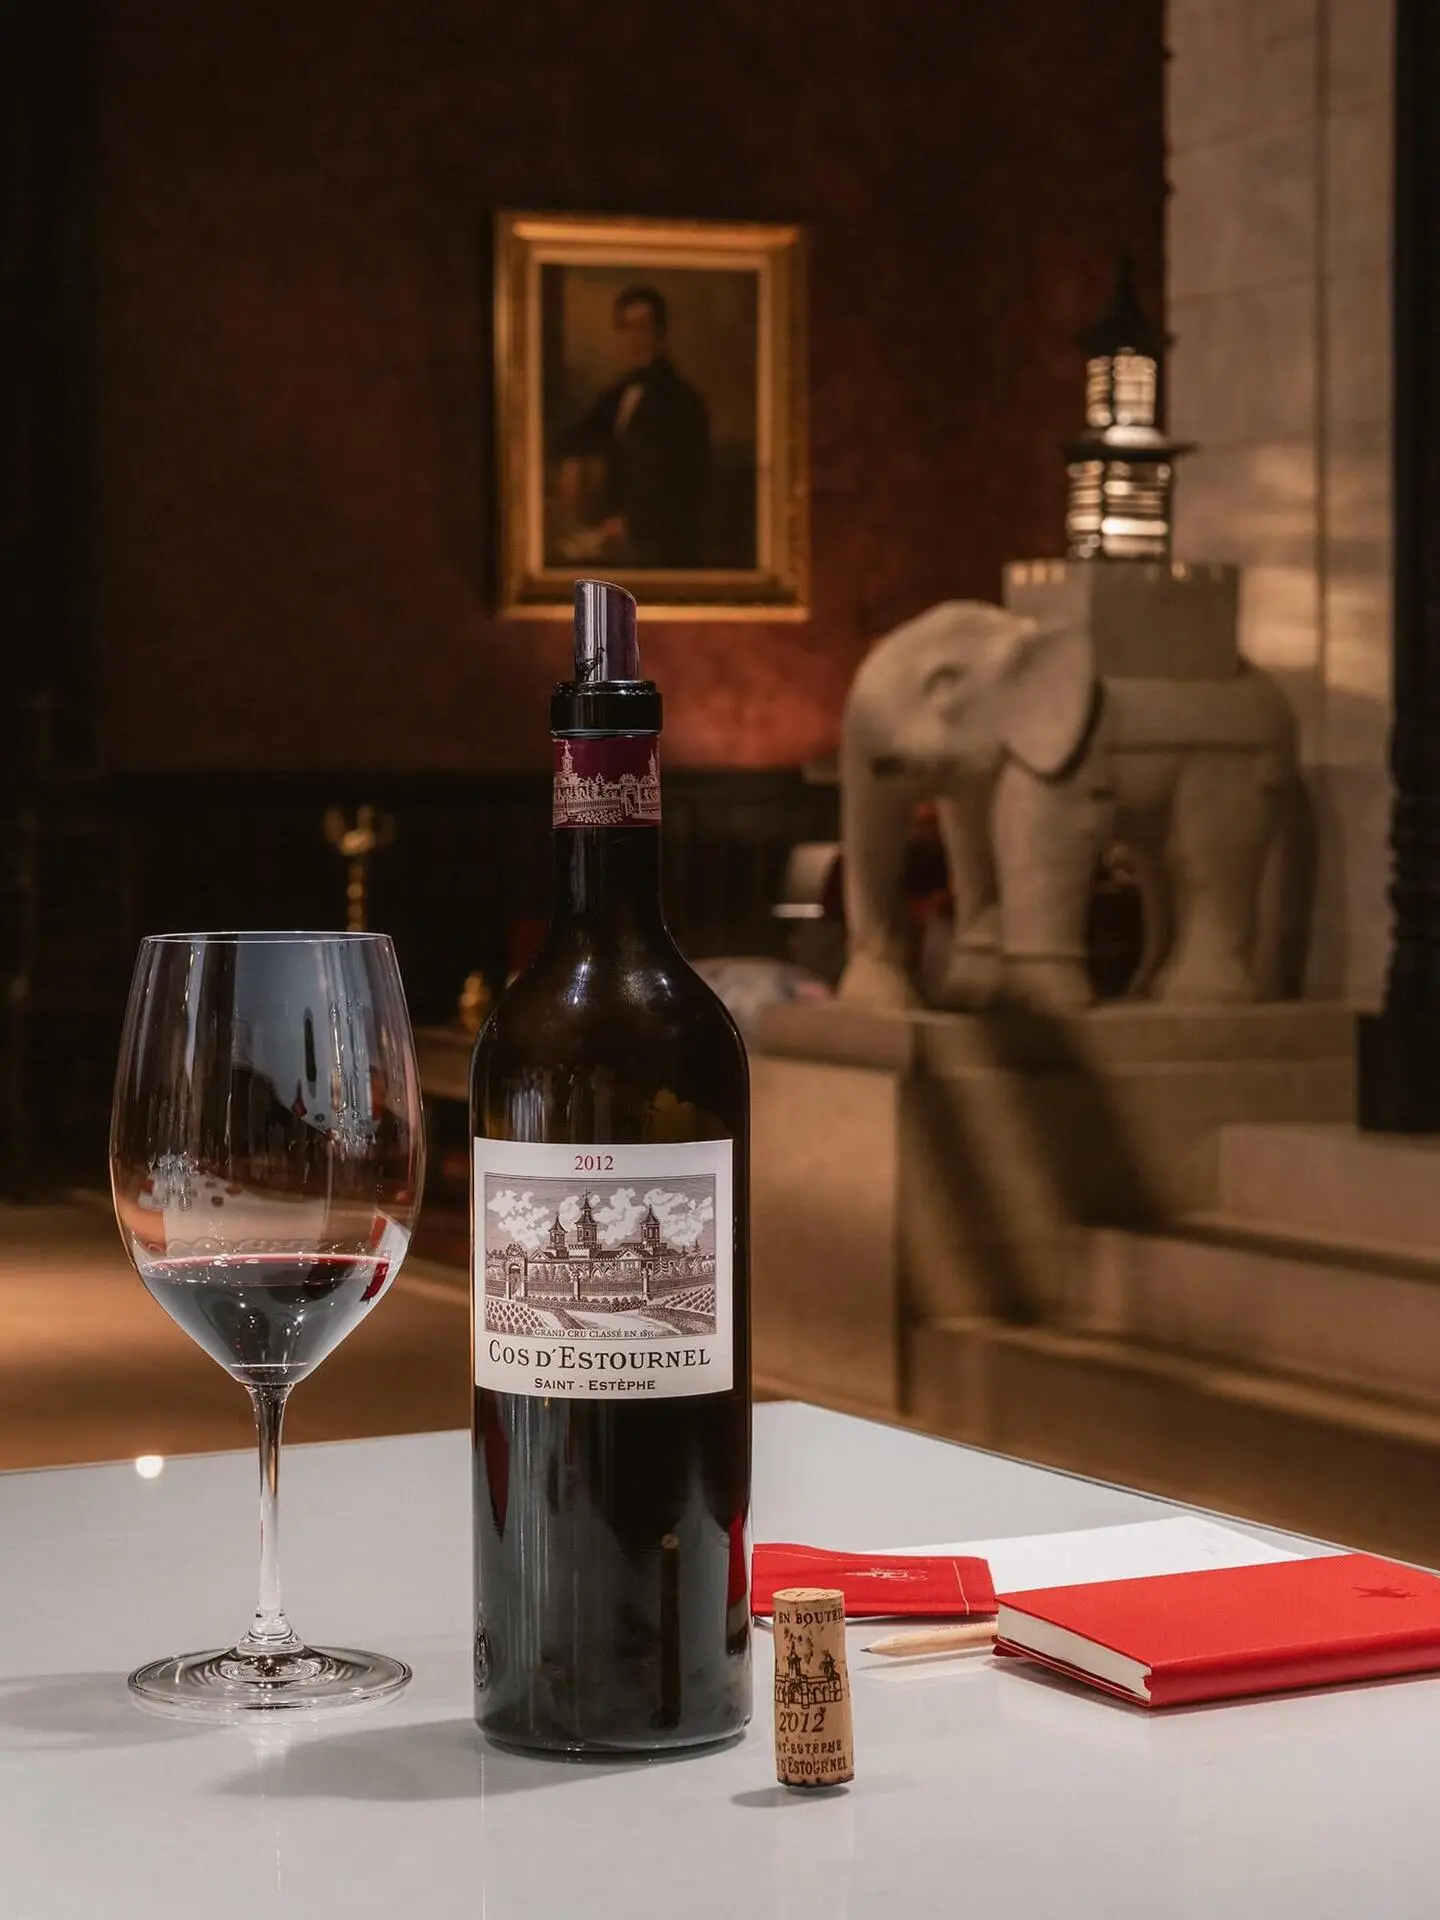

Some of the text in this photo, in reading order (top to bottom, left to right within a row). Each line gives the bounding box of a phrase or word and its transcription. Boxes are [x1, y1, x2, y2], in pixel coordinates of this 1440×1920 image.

[575, 1155, 614, 1171] 2012
[534, 1328, 565, 1337] GRAND
[567, 1329, 586, 1338] CRU
[589, 1328, 622, 1338] CLASSÉ
[639, 1329, 654, 1338] 1855
[489, 1340, 530, 1366] COS
[534, 1378, 574, 1391] SAINT
[589, 1378, 656, 1391] ESTÈPHE
[778, 1611, 790, 1624] EN
[779, 1711, 826, 1734] 2012
